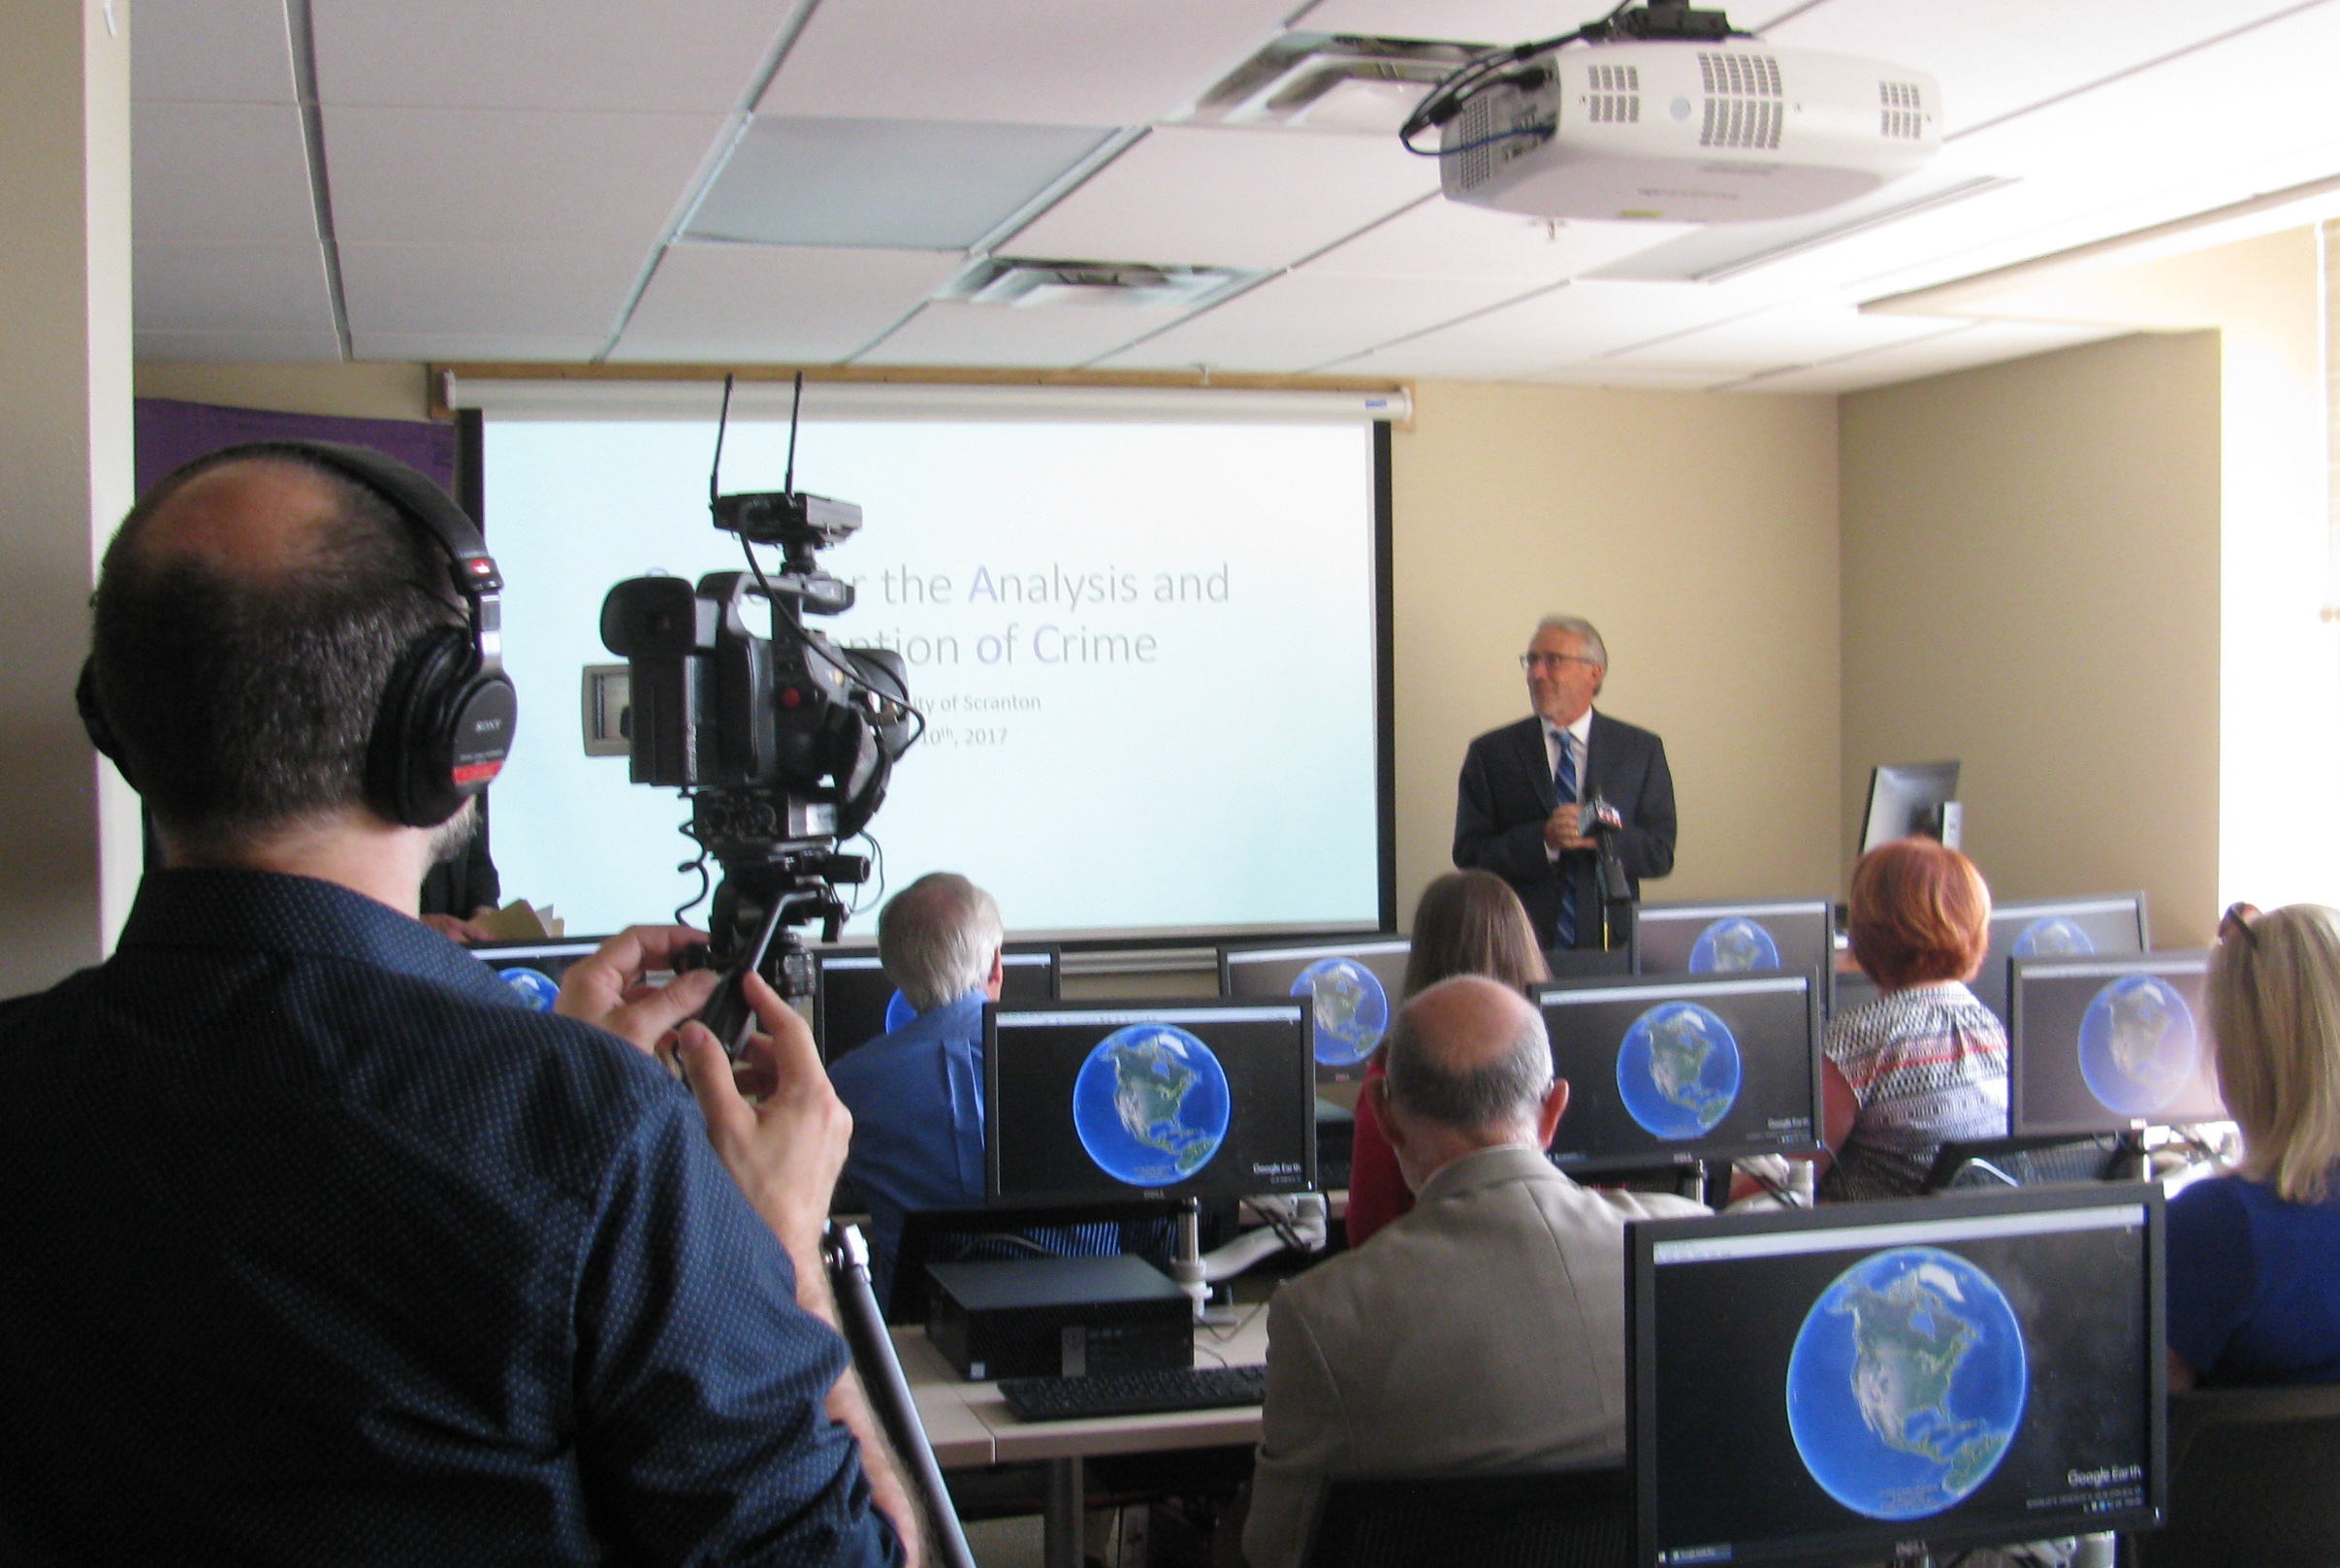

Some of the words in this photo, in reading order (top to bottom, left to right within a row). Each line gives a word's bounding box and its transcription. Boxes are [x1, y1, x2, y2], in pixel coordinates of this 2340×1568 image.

[881, 563, 952, 605] the
[969, 562, 1138, 613] Analysis
[1153, 562, 1230, 604] and
[976, 623, 1019, 665] of
[1033, 624, 1158, 664] Crime
[940, 693, 957, 711] of
[964, 694, 1042, 711] Scranton
[965, 728, 1008, 746] 2017
[2068, 1465, 2111, 1488] Google
[2112, 1462, 2141, 1482] Earth
